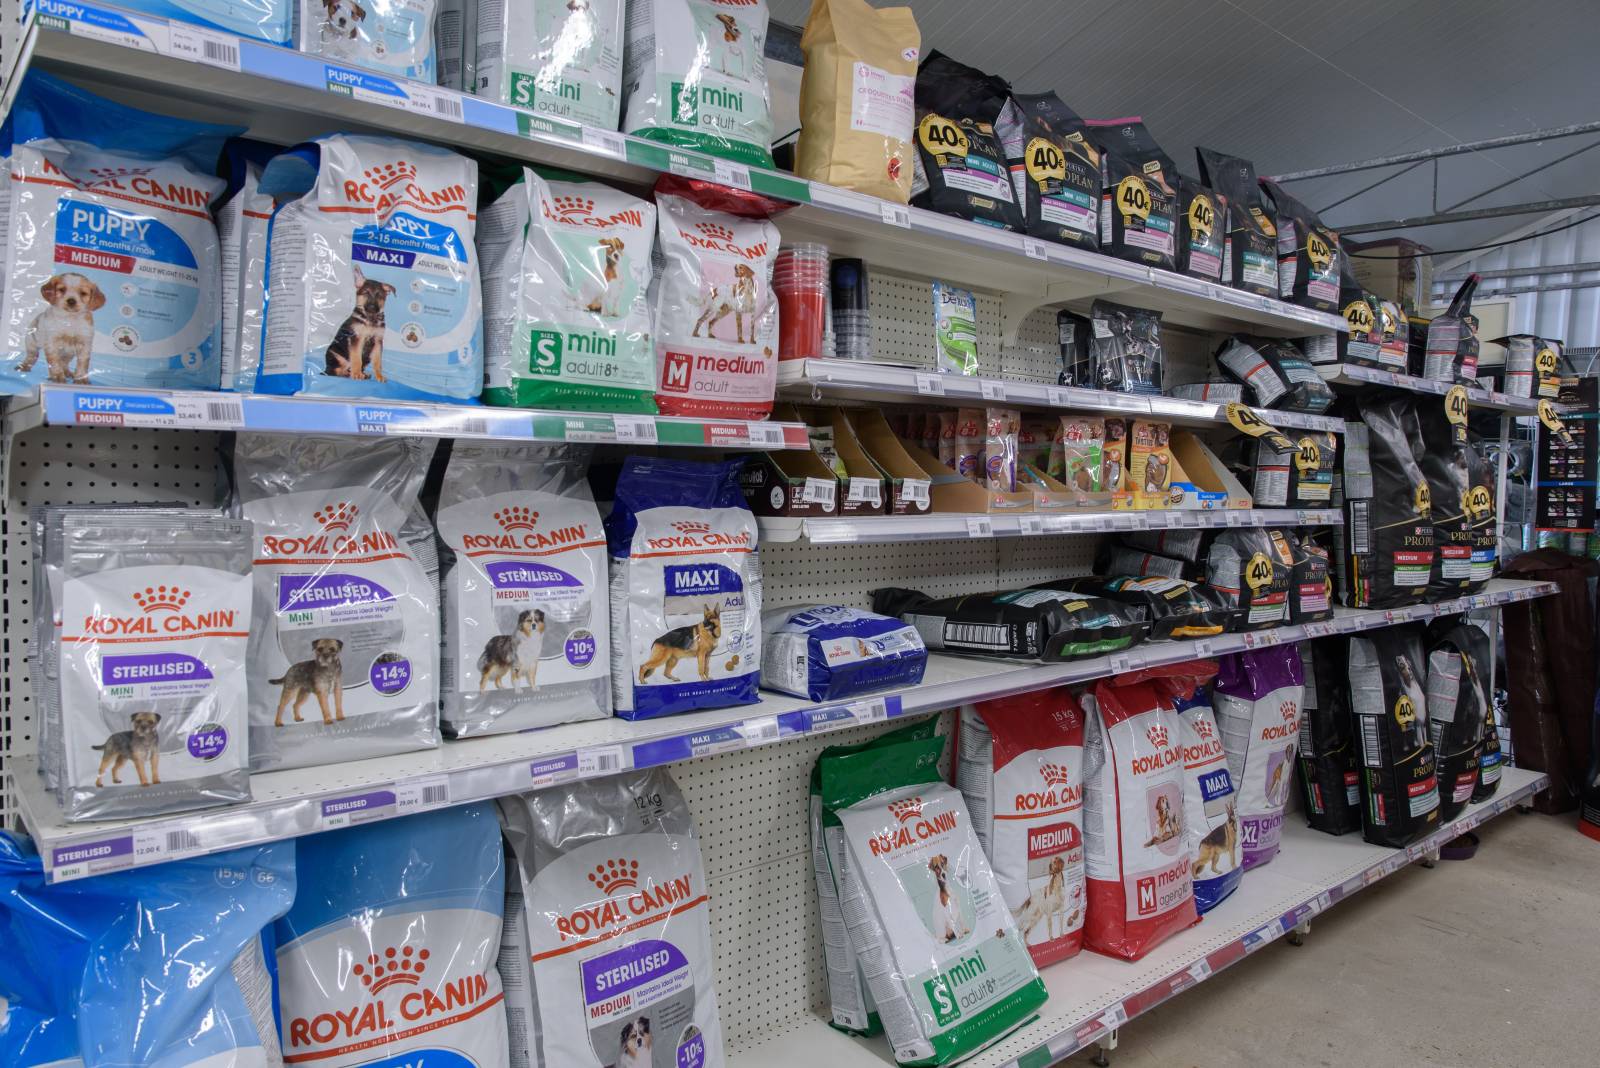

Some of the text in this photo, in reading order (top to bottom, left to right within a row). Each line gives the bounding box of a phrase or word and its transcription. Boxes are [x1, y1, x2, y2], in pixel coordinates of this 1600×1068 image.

[38, 0, 84, 19] PUPPY
[38, 15, 67, 30] MINI
[328, 68, 363, 85] PUPPY
[329, 83, 350, 95] MINI
[515, 78, 531, 102] S
[702, 86, 743, 112] mini
[538, 101, 571, 116] adult
[530, 118, 553, 133] MINI
[702, 113, 736, 130] adult
[669, 153, 689, 166] MINI
[131, 177, 212, 208] CANIN
[72, 208, 151, 241] PUPPY
[584, 210, 644, 229] CANIN
[72, 231, 97, 245] 2-12
[367, 231, 390, 244] 2-15
[71, 251, 121, 269] MEDIUM
[365, 249, 405, 265] MAXI
[536, 337, 556, 367] S
[568, 331, 617, 357] mini
[188, 352, 197, 365] 3
[697, 354, 765, 375] medium
[668, 359, 689, 386] M
[694, 378, 730, 394] adult
[78, 397, 123, 411] PUPPY
[79, 412, 122, 424] MEDIUM
[359, 410, 393, 421] PUPPY
[360, 423, 385, 434] MAXI
[565, 420, 585, 429] MINI
[711, 427, 738, 437] MEDIUM
[264, 530, 399, 556] ROYAL CANIN
[463, 525, 587, 550] ROYAL CANIN
[648, 535, 702, 549] ROYAL
[498, 569, 564, 583] STERILISED
[674, 569, 720, 589] MAXI
[288, 583, 372, 604] STERILISED
[496, 591, 530, 600] MEDIUM
[85, 610, 235, 636] ROYAL CANIN
[288, 611, 313, 623] MINI
[568, 641, 594, 654] -10%
[112, 661, 195, 679] STERILISED
[375, 664, 408, 681] -14%
[110, 686, 134, 696] MINI
[812, 712, 828, 722] MAXI
[192, 733, 224, 749] -14%
[691, 736, 710, 745] MAXI
[1261, 725, 1288, 741] ROYAL
[1183, 743, 1213, 763] ROYAL
[533, 761, 566, 775] STERILISED
[1132, 754, 1165, 775] ROYAL
[1206, 774, 1228, 794] MAXI
[326, 799, 367, 813] STERILISED
[634, 797, 647, 809] 12
[1016, 791, 1060, 812] ROYAL
[329, 818, 344, 826] MINI
[869, 811, 957, 857] ROYAL CANIN
[1030, 827, 1073, 851] MEDIUM
[57, 846, 112, 863] STERILISED
[61, 868, 81, 877] MINI
[217, 869, 245, 880] 15 kg
[1140, 884, 1154, 909] M
[557, 876, 693, 941] ROYAL CANIN
[595, 949, 670, 992] STERILISED
[949, 949, 987, 988] mini
[590, 994, 632, 1019] MEDIUM
[933, 984, 953, 1015] S
[290, 974, 488, 1048] ROYAL CANIN
[338, 1041, 370, 1054] HEALTH
[416, 1023, 440, 1035] SINCE
[681, 1042, 703, 1062] -10%
